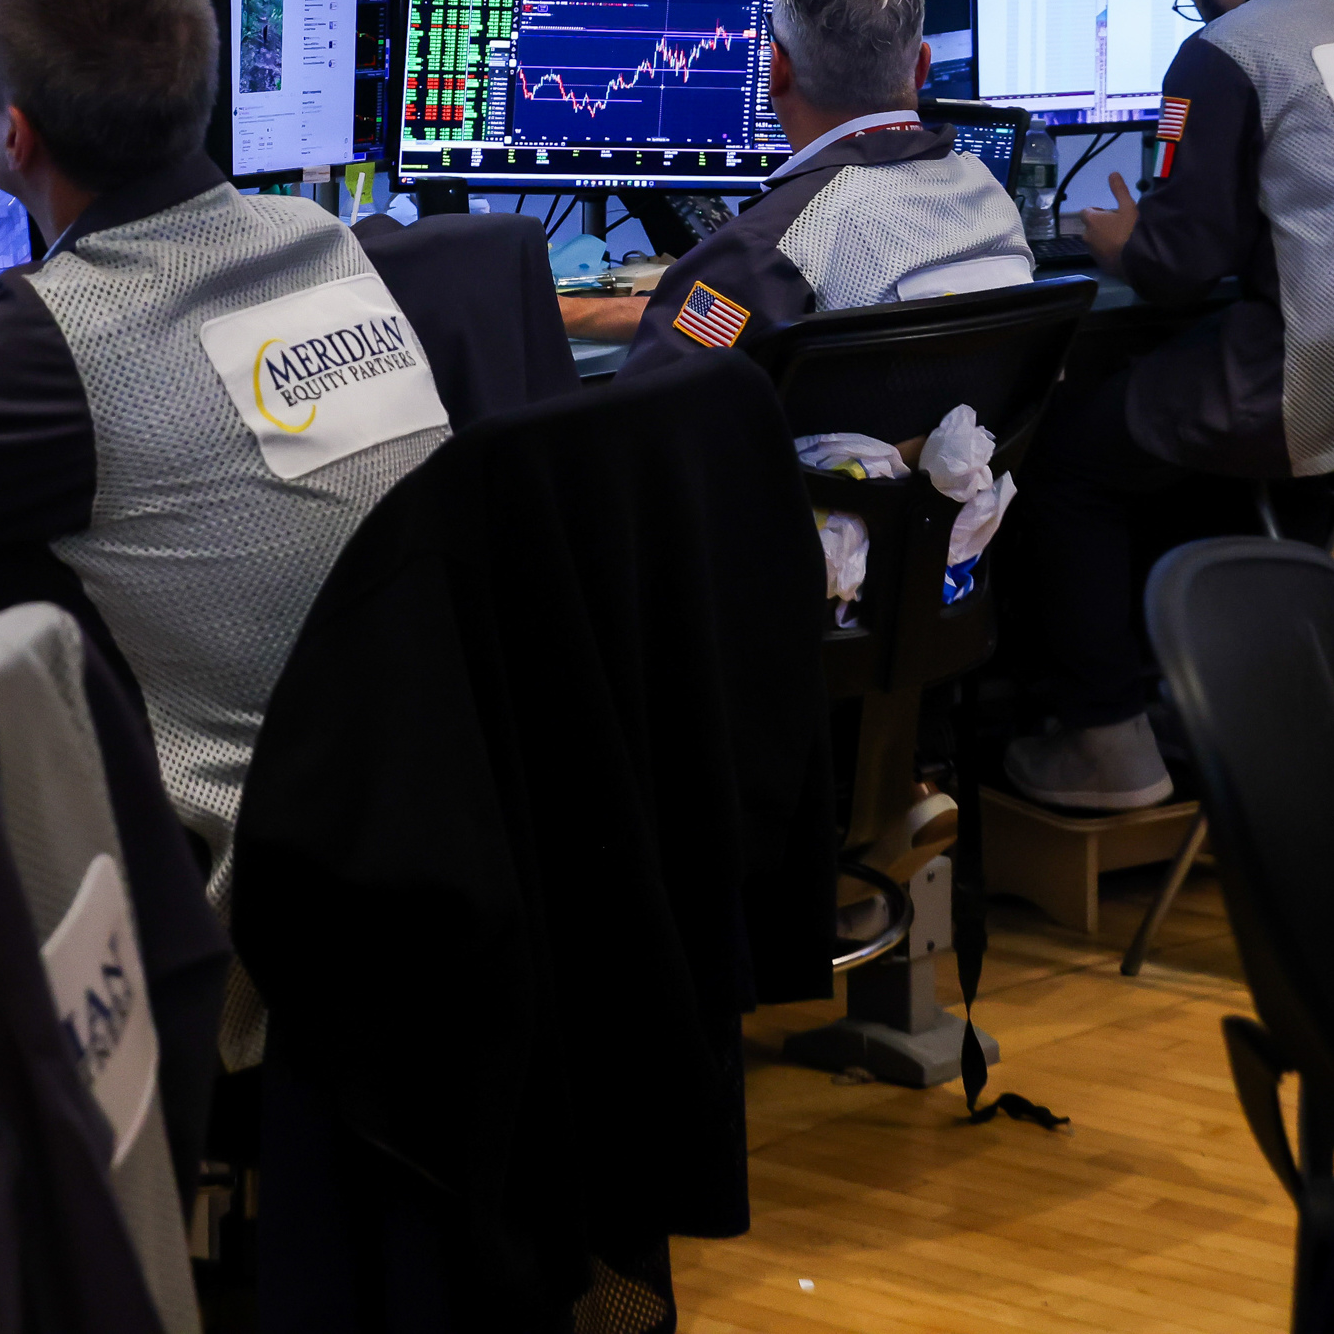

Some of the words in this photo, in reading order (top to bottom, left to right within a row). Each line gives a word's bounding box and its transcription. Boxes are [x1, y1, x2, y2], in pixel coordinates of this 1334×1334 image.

[265, 316, 406, 391] MERIDIAN
[280, 369, 348, 407] EQUITY
[351, 349, 417, 383] PARTNERS
